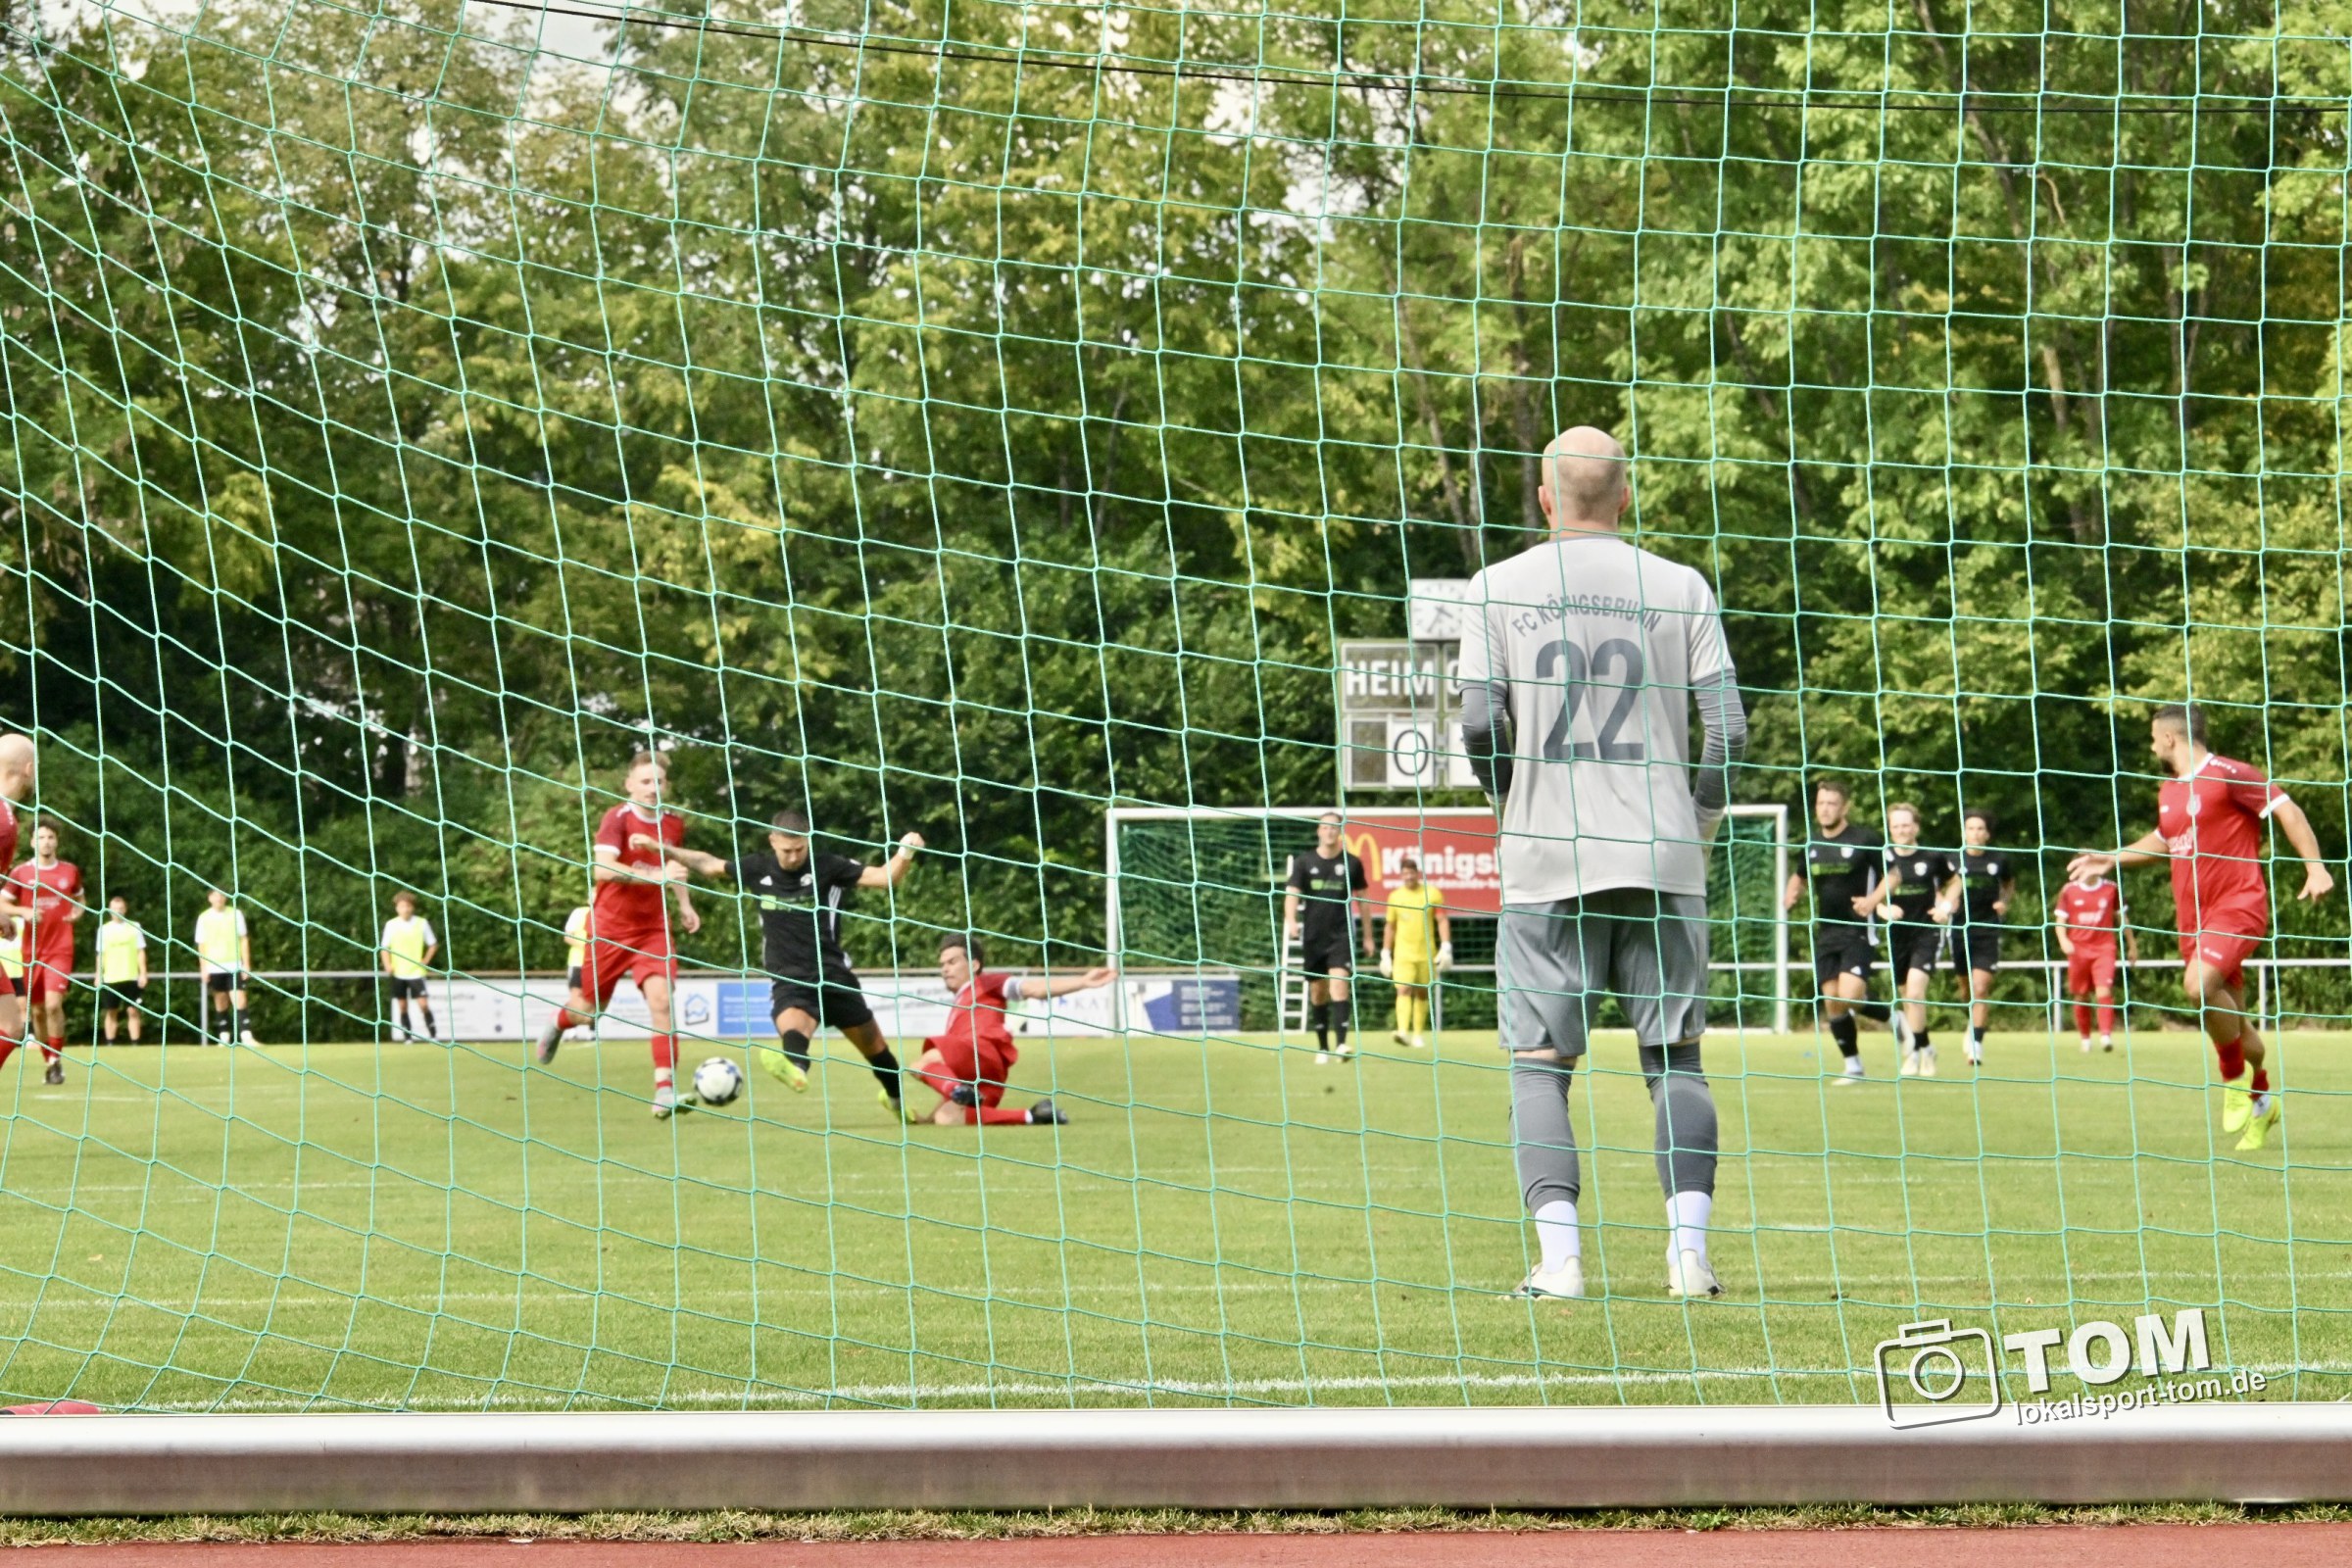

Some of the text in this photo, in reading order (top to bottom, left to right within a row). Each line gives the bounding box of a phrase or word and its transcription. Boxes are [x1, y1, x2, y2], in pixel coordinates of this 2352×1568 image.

[1511, 593, 1662, 637] FC KÖNIGSBRUNN
[1346, 660, 1434, 696] HEIM
[1536, 638, 1645, 762] 22
[1382, 846, 1500, 879] Königs
